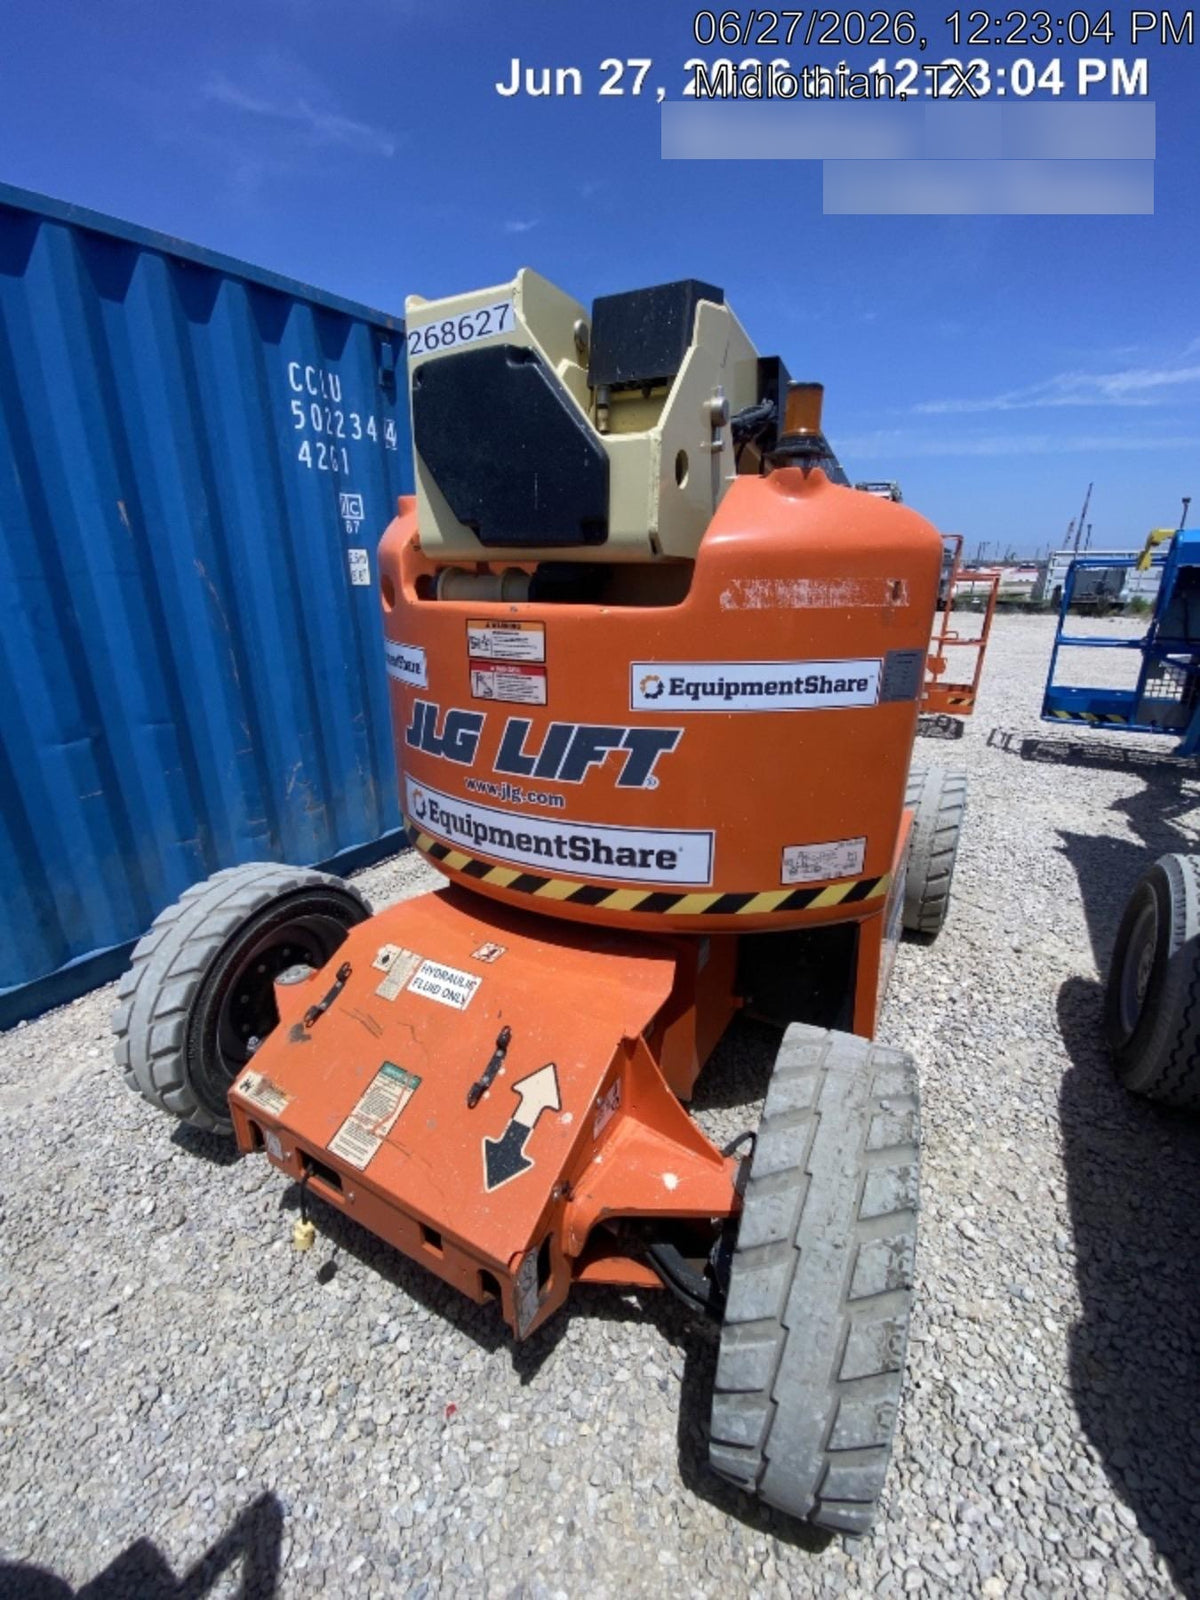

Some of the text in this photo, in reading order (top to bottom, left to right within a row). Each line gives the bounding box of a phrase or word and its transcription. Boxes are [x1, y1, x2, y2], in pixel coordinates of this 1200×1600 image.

[408, 304, 510, 356] 268627
[668, 675, 869, 701] EquipmentShare
[405, 699, 487, 767] JLG
[464, 777, 566, 808] www.jlg.com
[427, 798, 679, 871] EquipmentShare
[412, 977, 442, 995] FLUID
